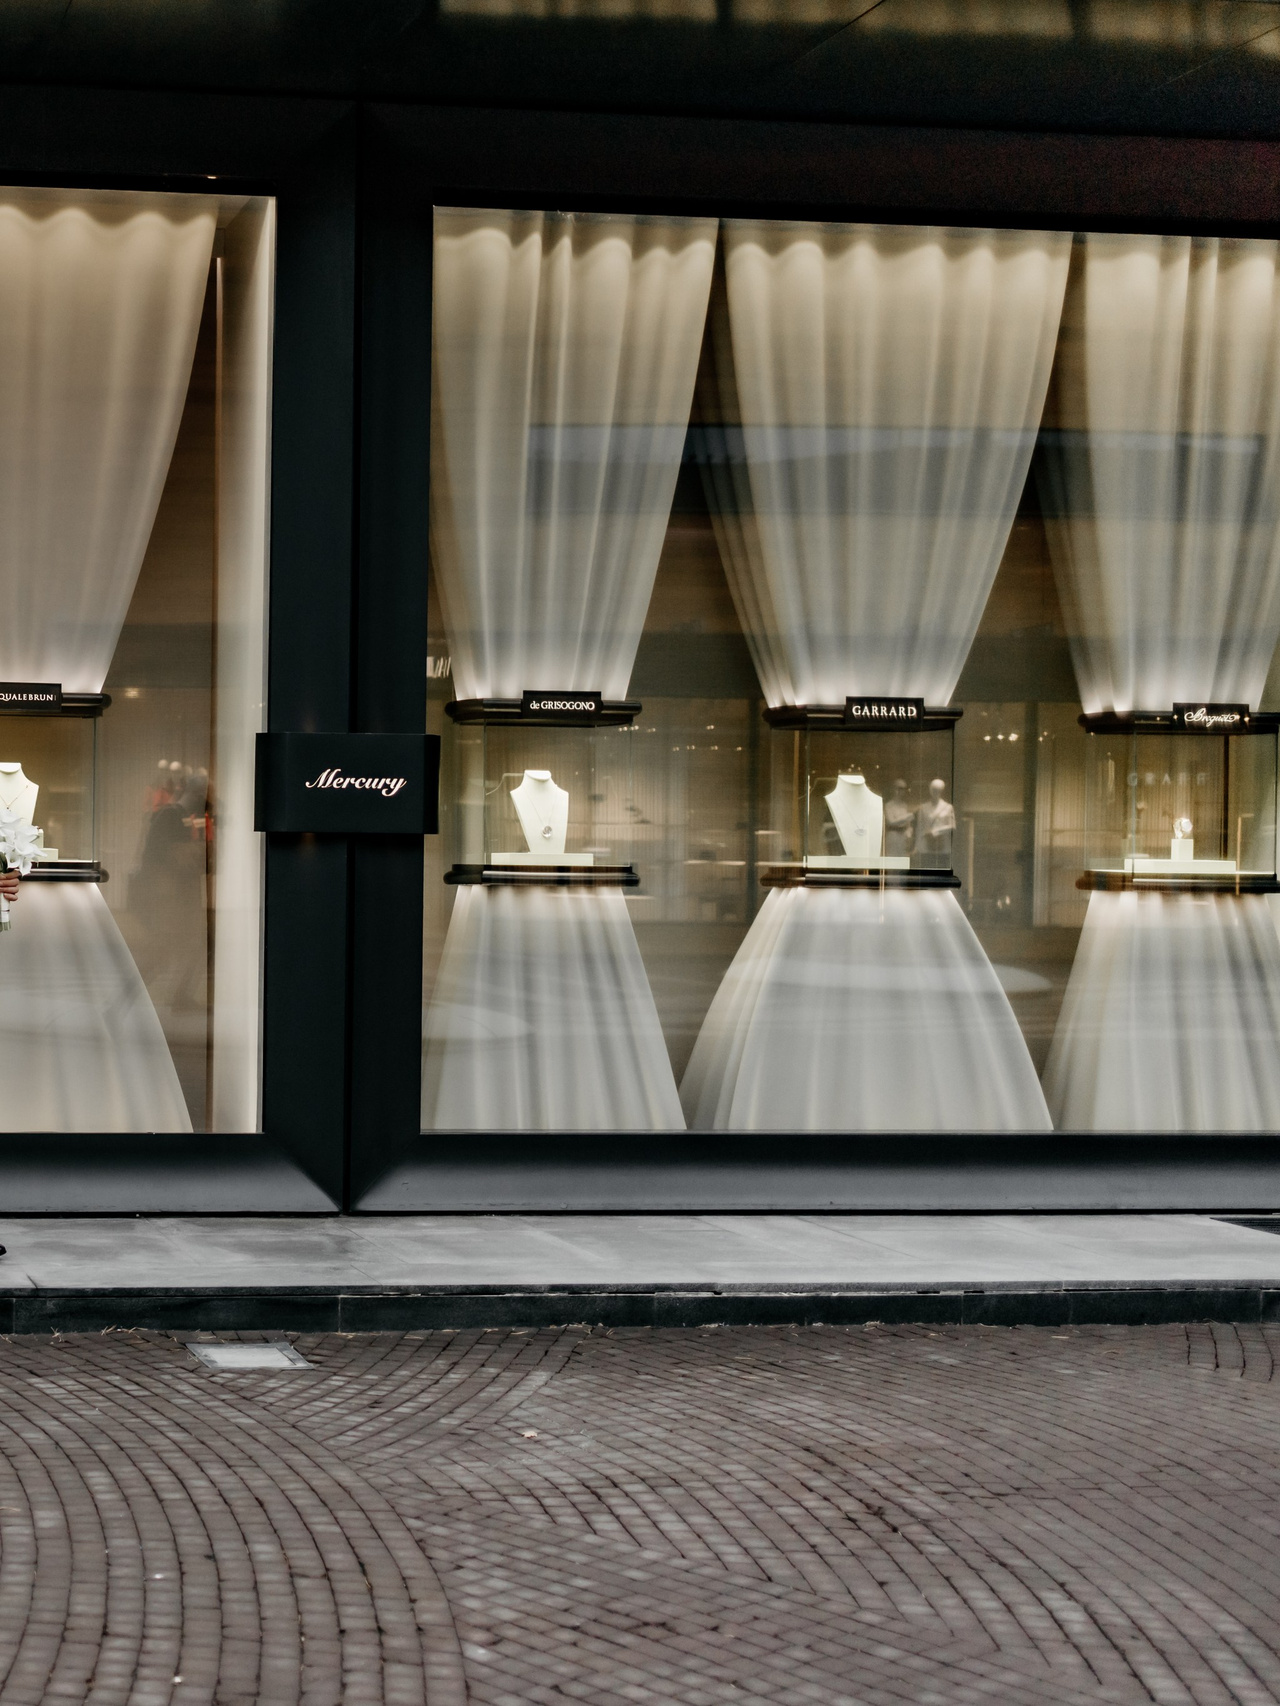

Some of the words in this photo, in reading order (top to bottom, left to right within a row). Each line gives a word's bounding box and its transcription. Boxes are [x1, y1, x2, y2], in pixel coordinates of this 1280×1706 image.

[529, 700, 540, 710] de
[540, 701, 596, 711] GRISOGONO
[851, 705, 918, 717] GARRARD
[305, 768, 408, 797] Mercury
